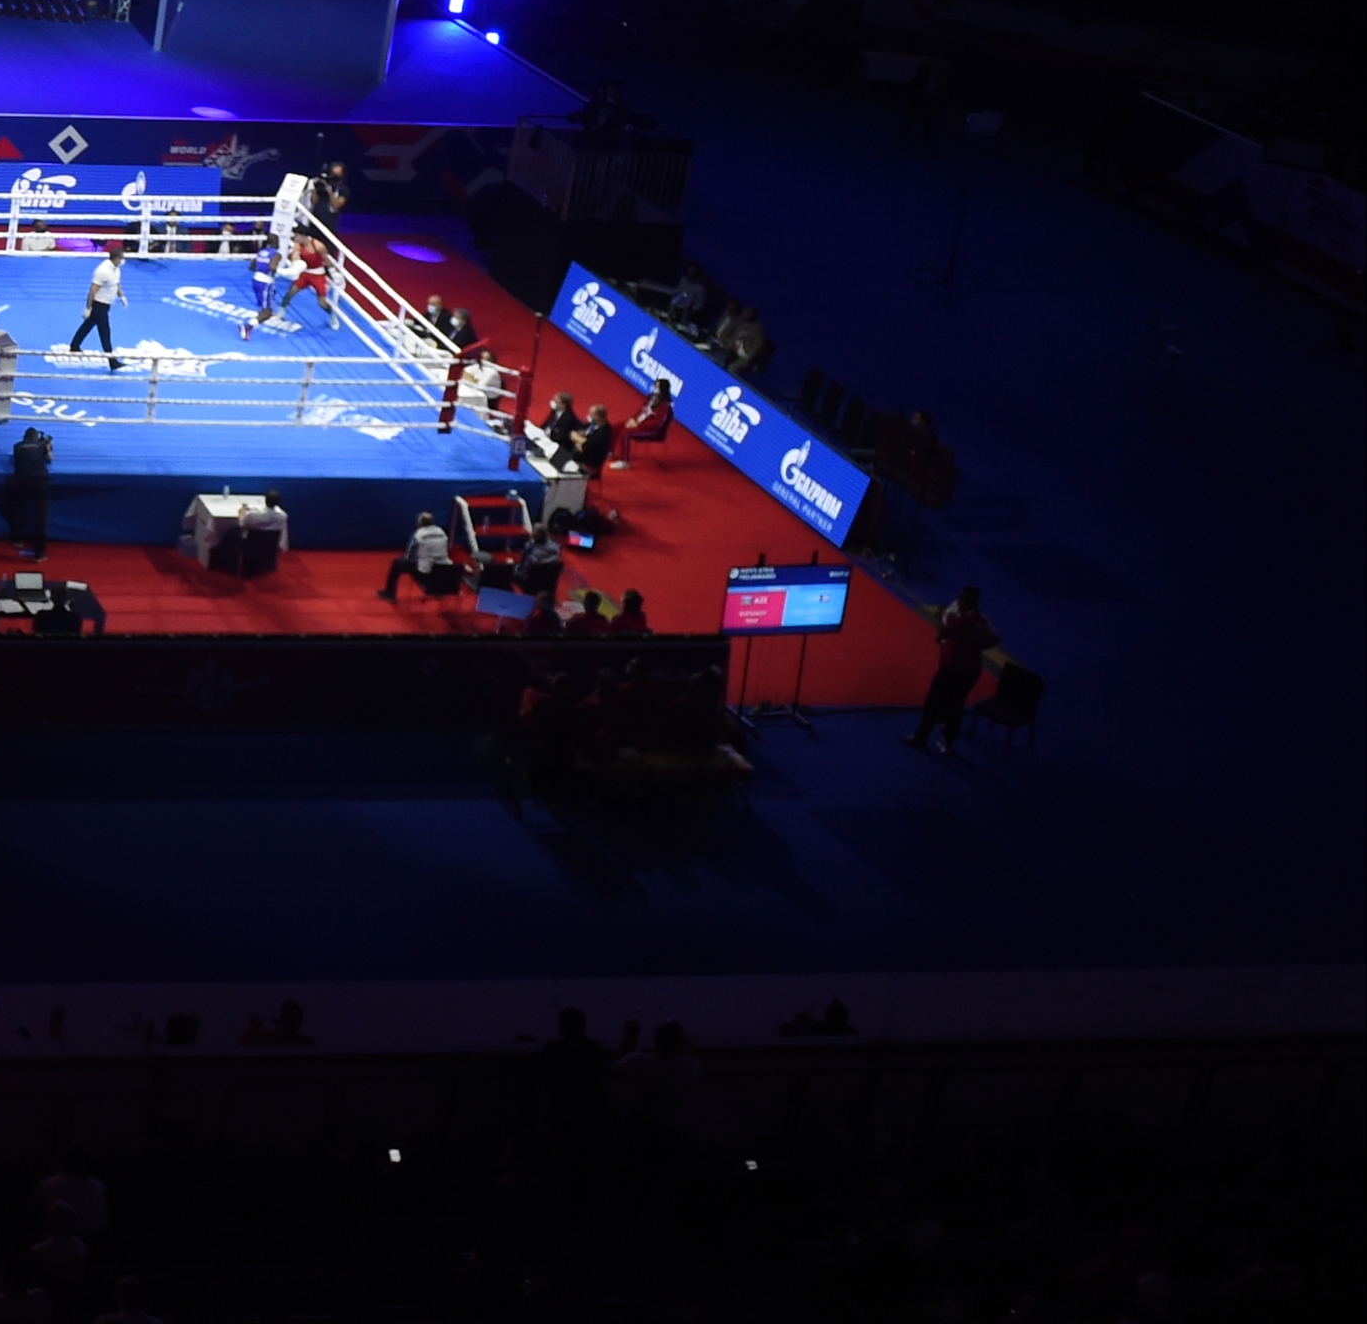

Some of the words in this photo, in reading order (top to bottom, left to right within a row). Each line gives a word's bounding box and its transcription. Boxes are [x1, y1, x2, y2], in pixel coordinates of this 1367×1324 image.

[169, 145, 207, 155] WORLD
[571, 300, 606, 335] aiba
[711, 405, 749, 444] aiba
[794, 472, 843, 521] GAZPROM
